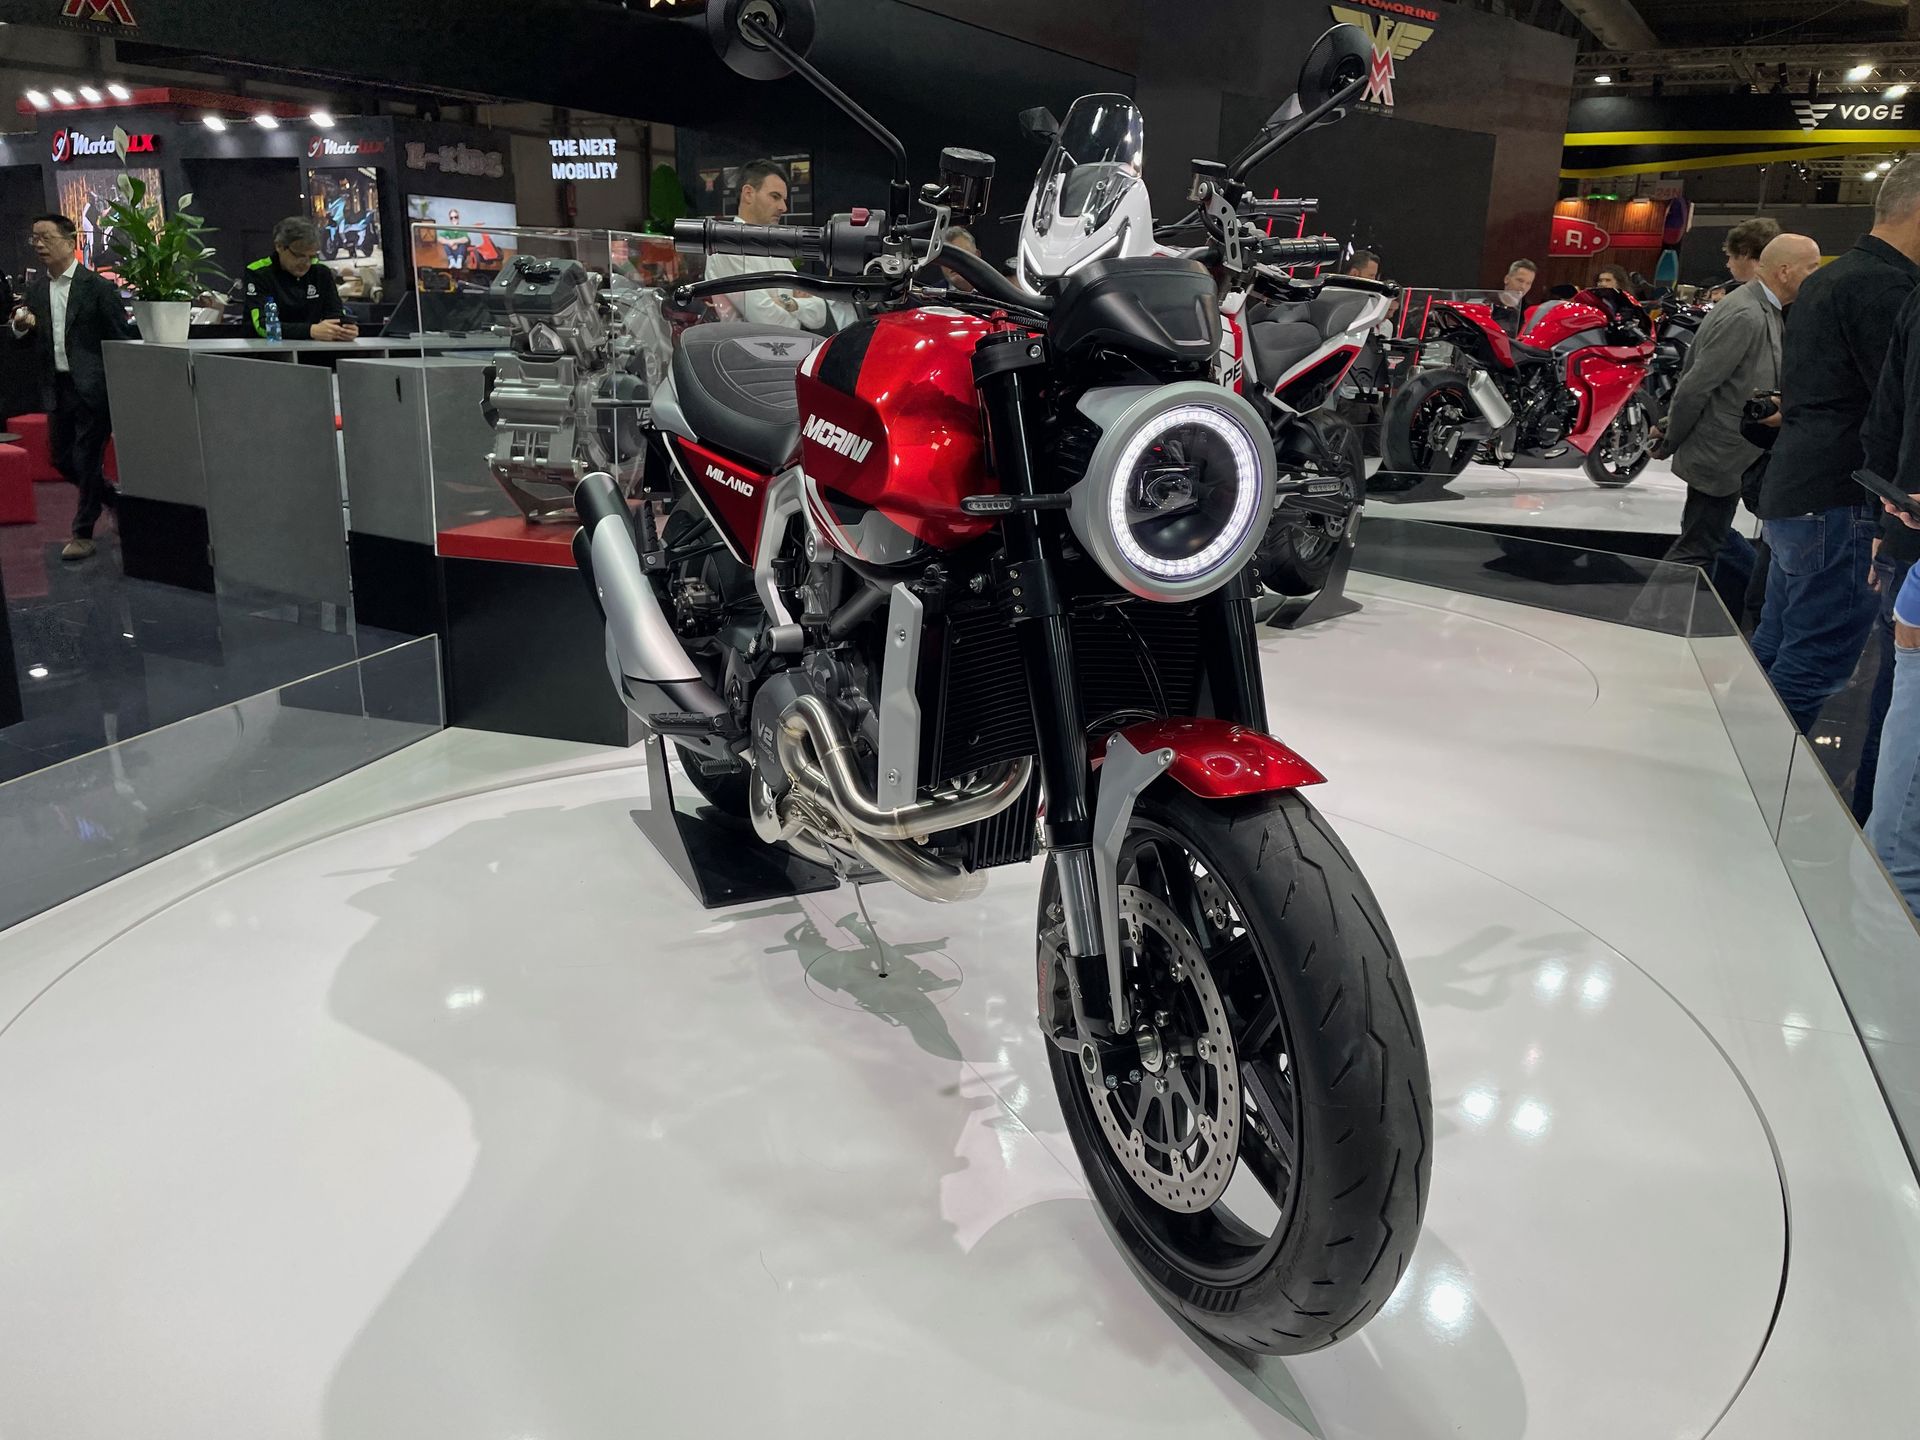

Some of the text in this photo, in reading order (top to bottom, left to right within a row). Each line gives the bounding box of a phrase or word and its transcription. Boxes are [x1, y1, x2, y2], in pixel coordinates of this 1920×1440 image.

[1840, 104, 1905, 121] VOGE
[549, 139, 616, 157] THE NEXT
[551, 162, 618, 180] MOBILITY
[802, 413, 873, 464] MORINI
[705, 464, 754, 497] MILANO
[757, 718, 774, 748] V2
